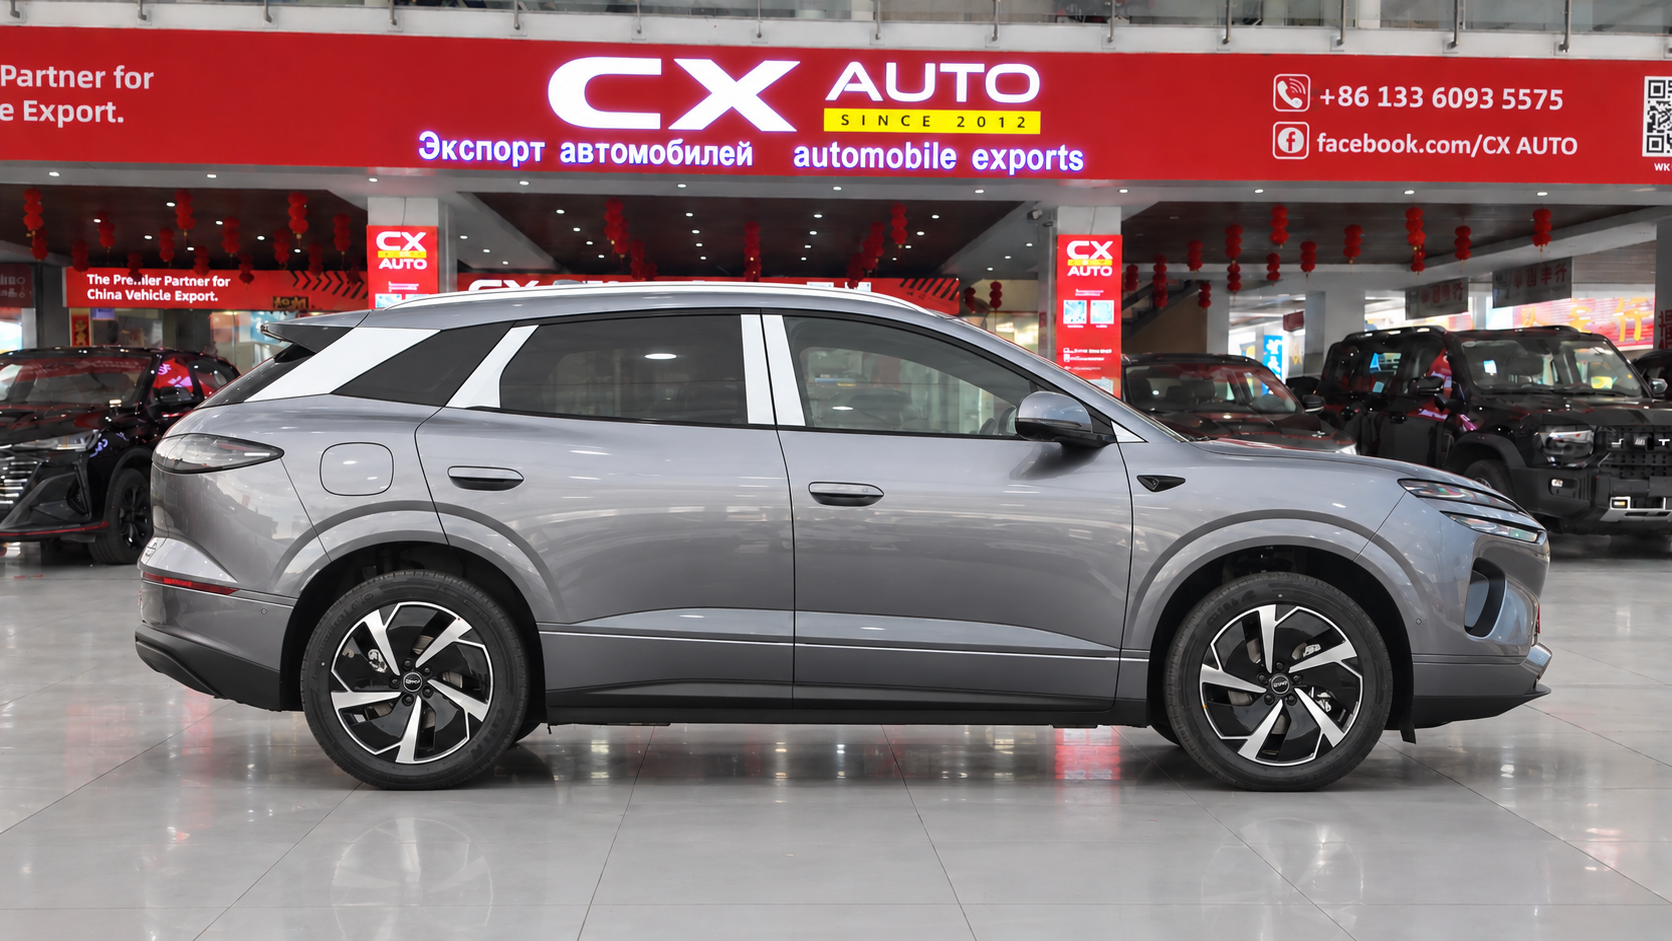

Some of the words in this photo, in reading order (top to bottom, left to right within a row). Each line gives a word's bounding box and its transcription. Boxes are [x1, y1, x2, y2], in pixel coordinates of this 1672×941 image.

[0, 64, 106, 88] Partner
[113, 65, 154, 90] for
[547, 57, 800, 132] CX
[826, 62, 1040, 104] AUTO
[1320, 86, 1369, 107] +86
[1378, 86, 1424, 107] 133
[1432, 87, 1494, 109] 6093
[1502, 88, 1563, 111] 5575
[23, 100, 124, 129] Export.
[841, 114, 930, 127] SINCE
[957, 116, 1026, 129] 2012
[418, 131, 546, 168] Экспорт
[559, 138, 753, 166] автомобилей
[1317, 132, 1511, 158] facebook.com/CX
[1515, 136, 1578, 155] AUTO
[793, 141, 957, 171] automobile
[972, 144, 1084, 176] exports
[376, 231, 427, 252] CX
[1066, 240, 1114, 259] CX
[378, 257, 428, 270] AUTO
[1067, 266, 1113, 277] AUTO
[87, 274, 111, 287] The
[113, 275, 161, 286] Preier
[164, 275, 209, 286] Partner
[212, 276, 231, 287] for
[87, 288, 122, 300] China
[125, 289, 171, 301] Vehicle
[175, 290, 219, 304] Export.
